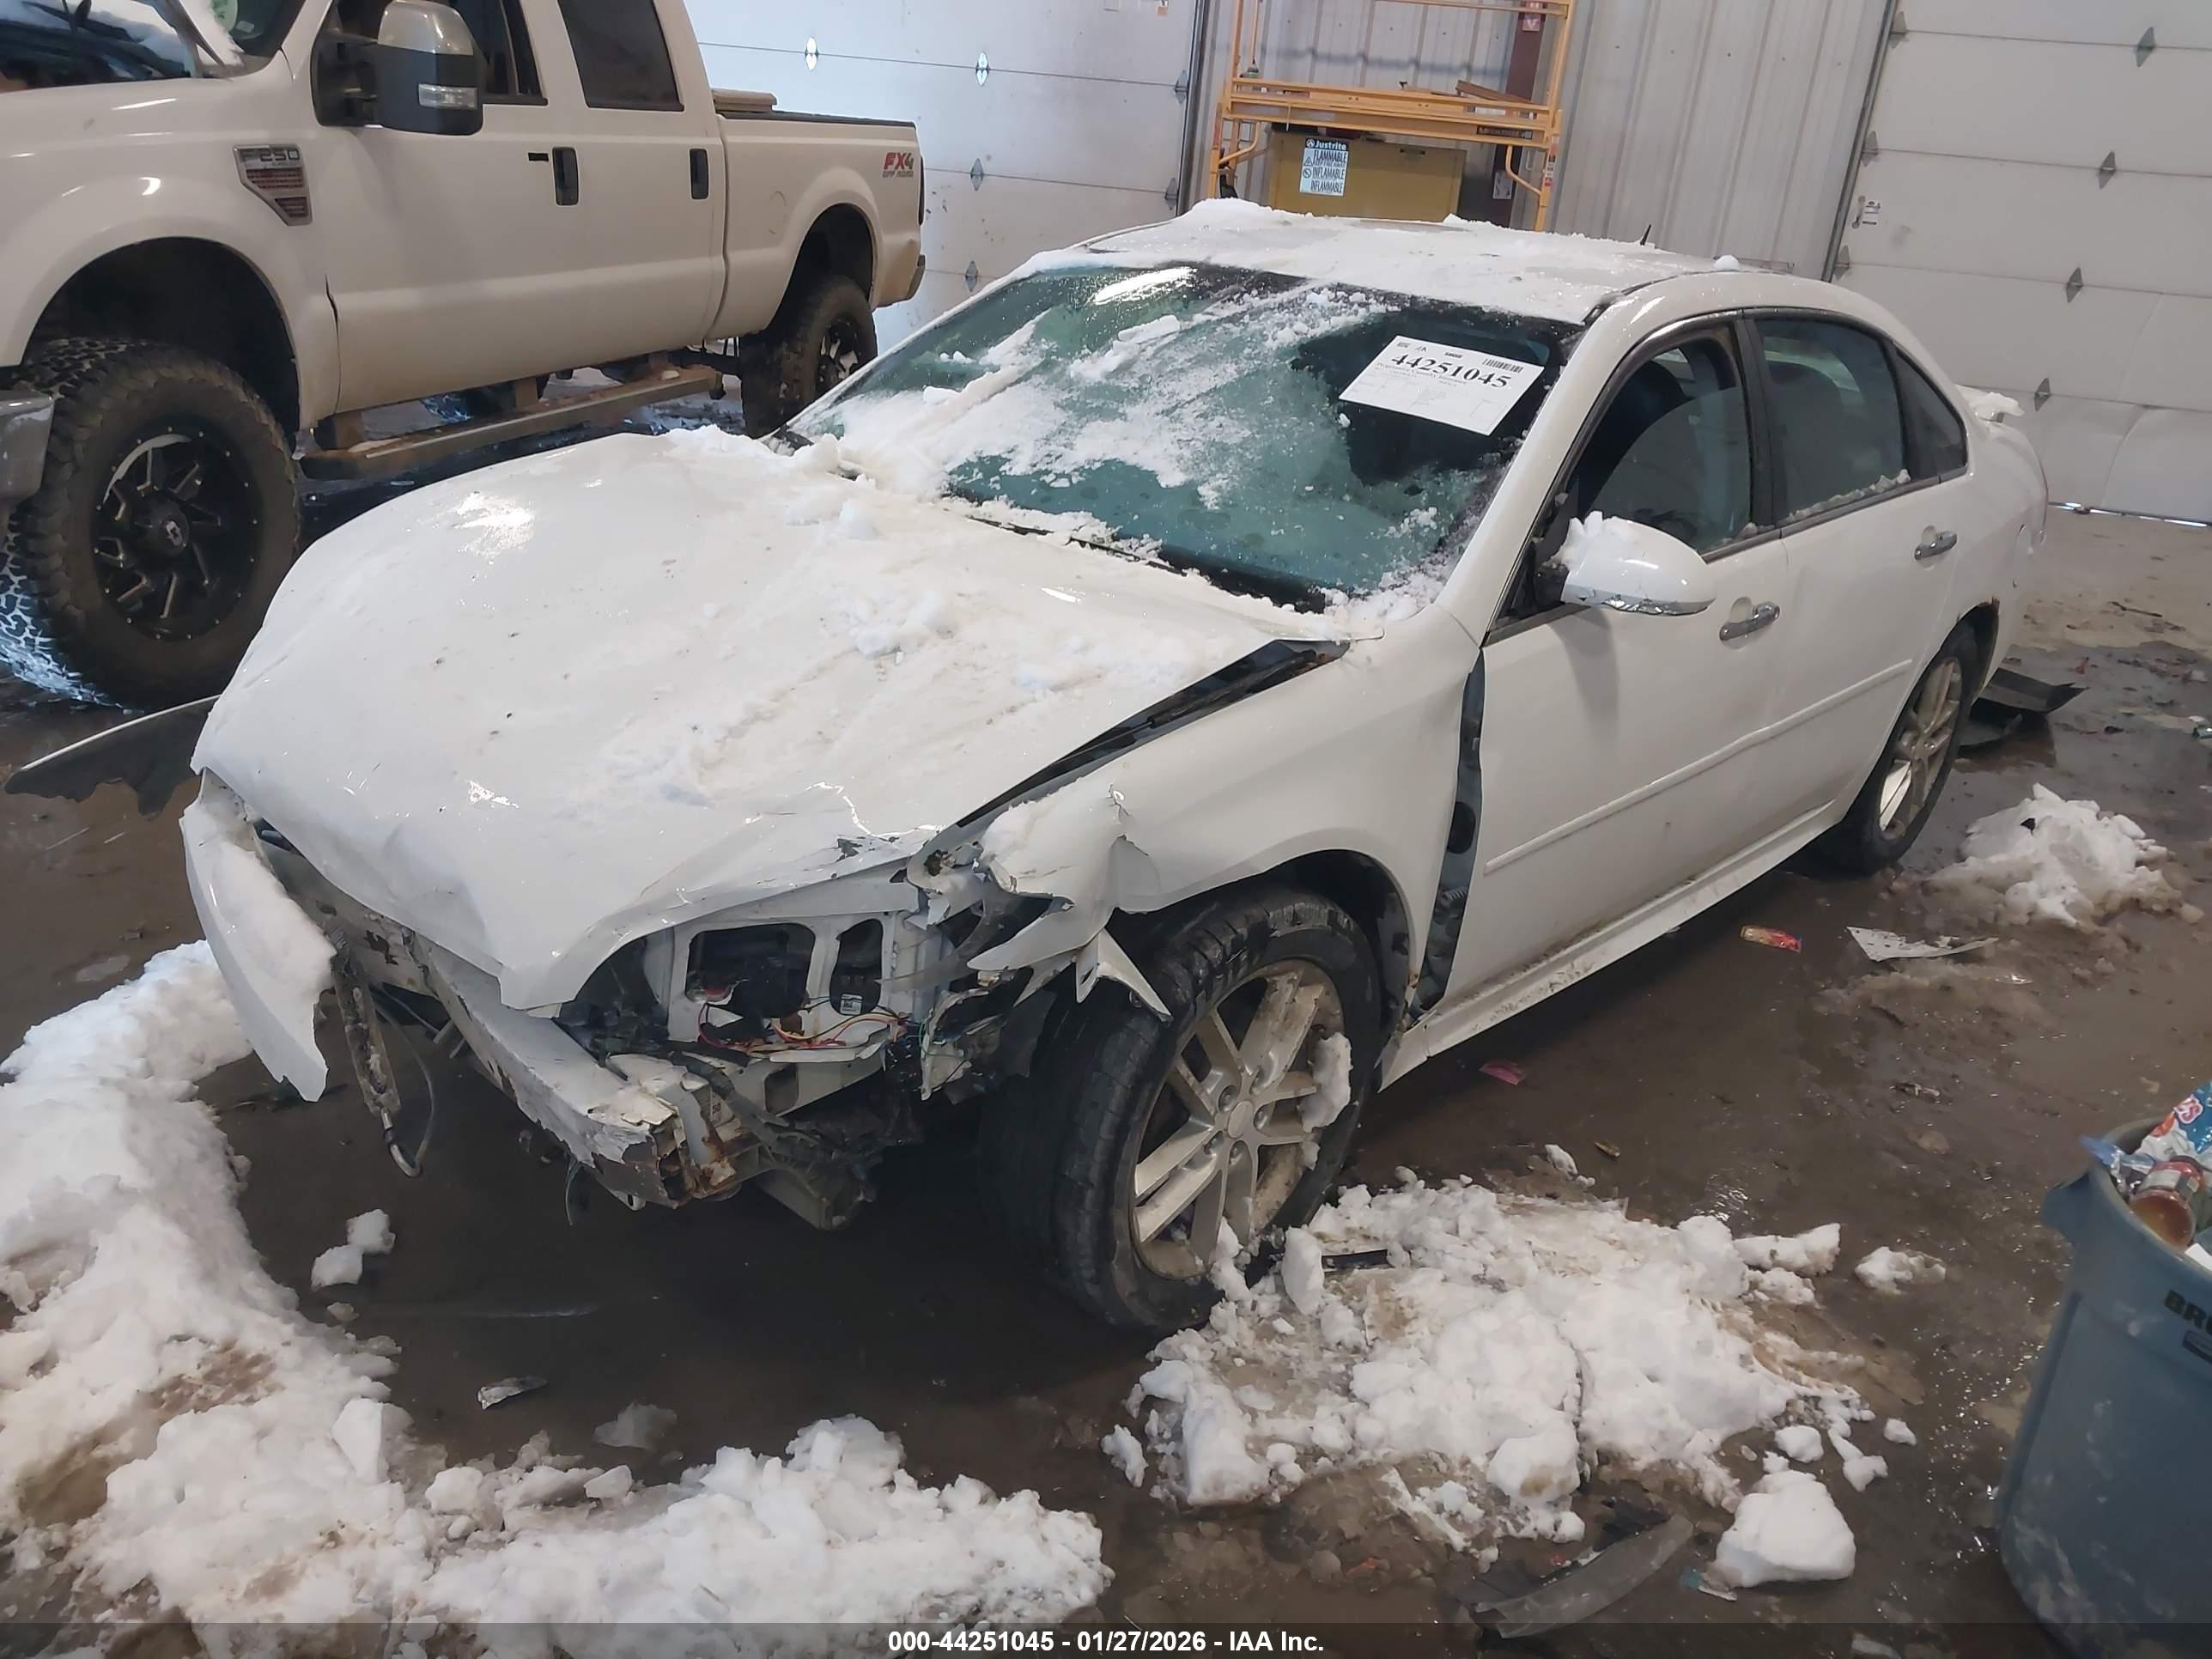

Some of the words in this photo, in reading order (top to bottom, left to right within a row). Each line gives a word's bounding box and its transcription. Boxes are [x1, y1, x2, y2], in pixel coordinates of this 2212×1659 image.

[1315, 140, 1347, 150] Justrite
[884, 152, 914, 170] FX4
[1313, 149, 1347, 162] FLAMMABLE
[1391, 354, 1512, 388] 44251045
